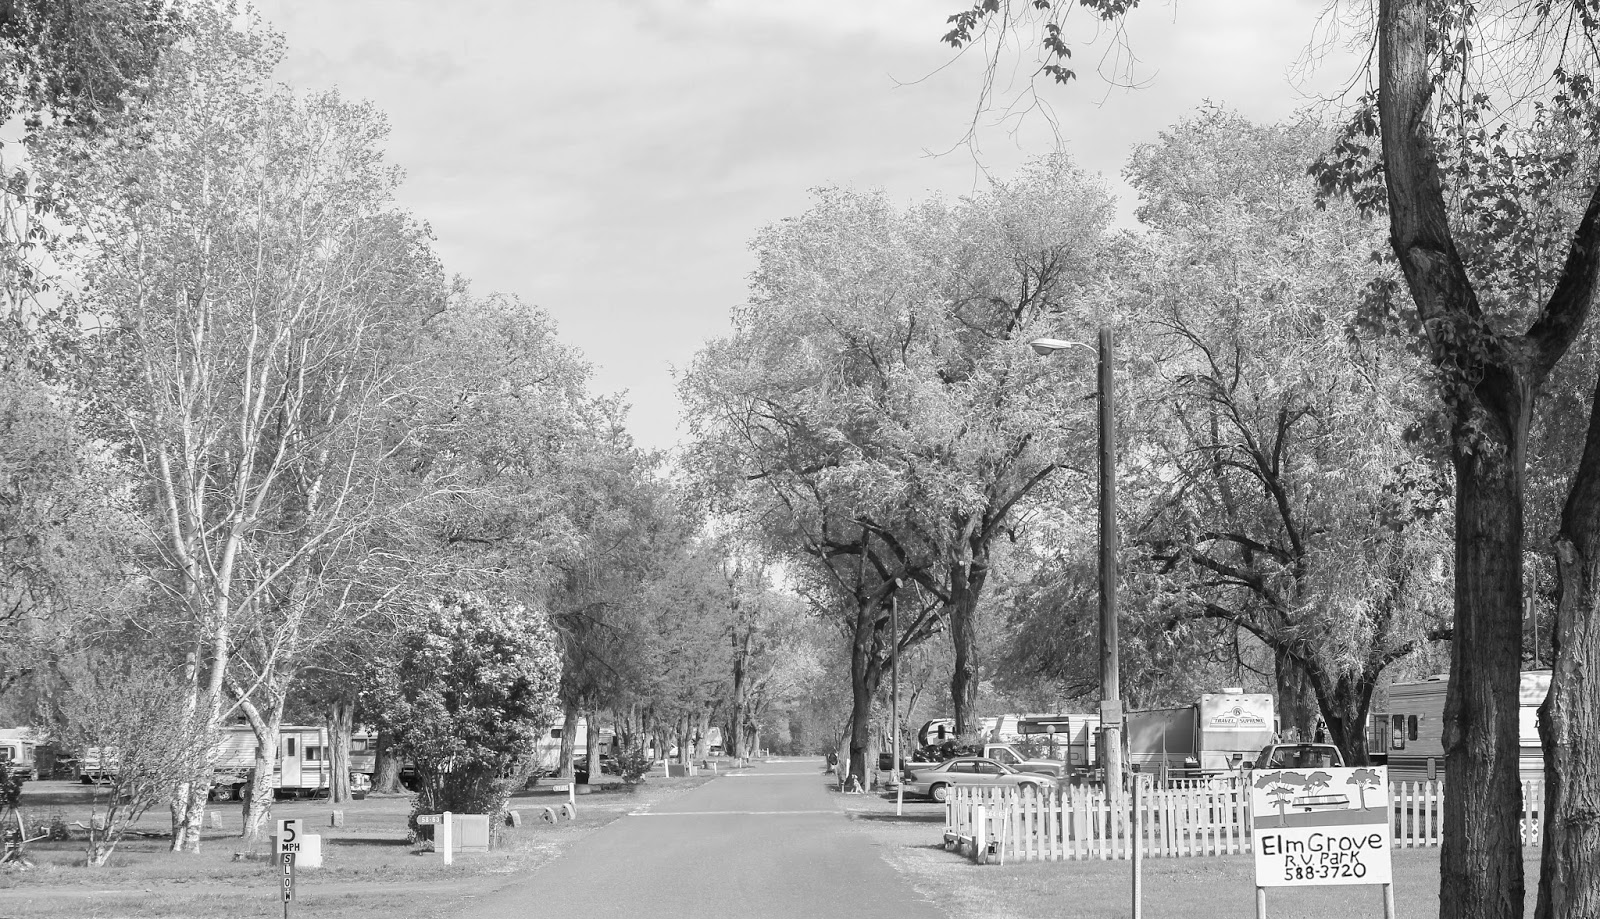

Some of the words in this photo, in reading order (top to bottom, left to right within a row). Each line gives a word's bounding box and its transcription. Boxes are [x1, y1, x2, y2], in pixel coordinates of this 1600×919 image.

[282, 820, 296, 843] 5
[281, 843, 300, 851] MPH
[1320, 851, 1360, 865] Park
[1284, 862, 1367, 881] 588-3720
